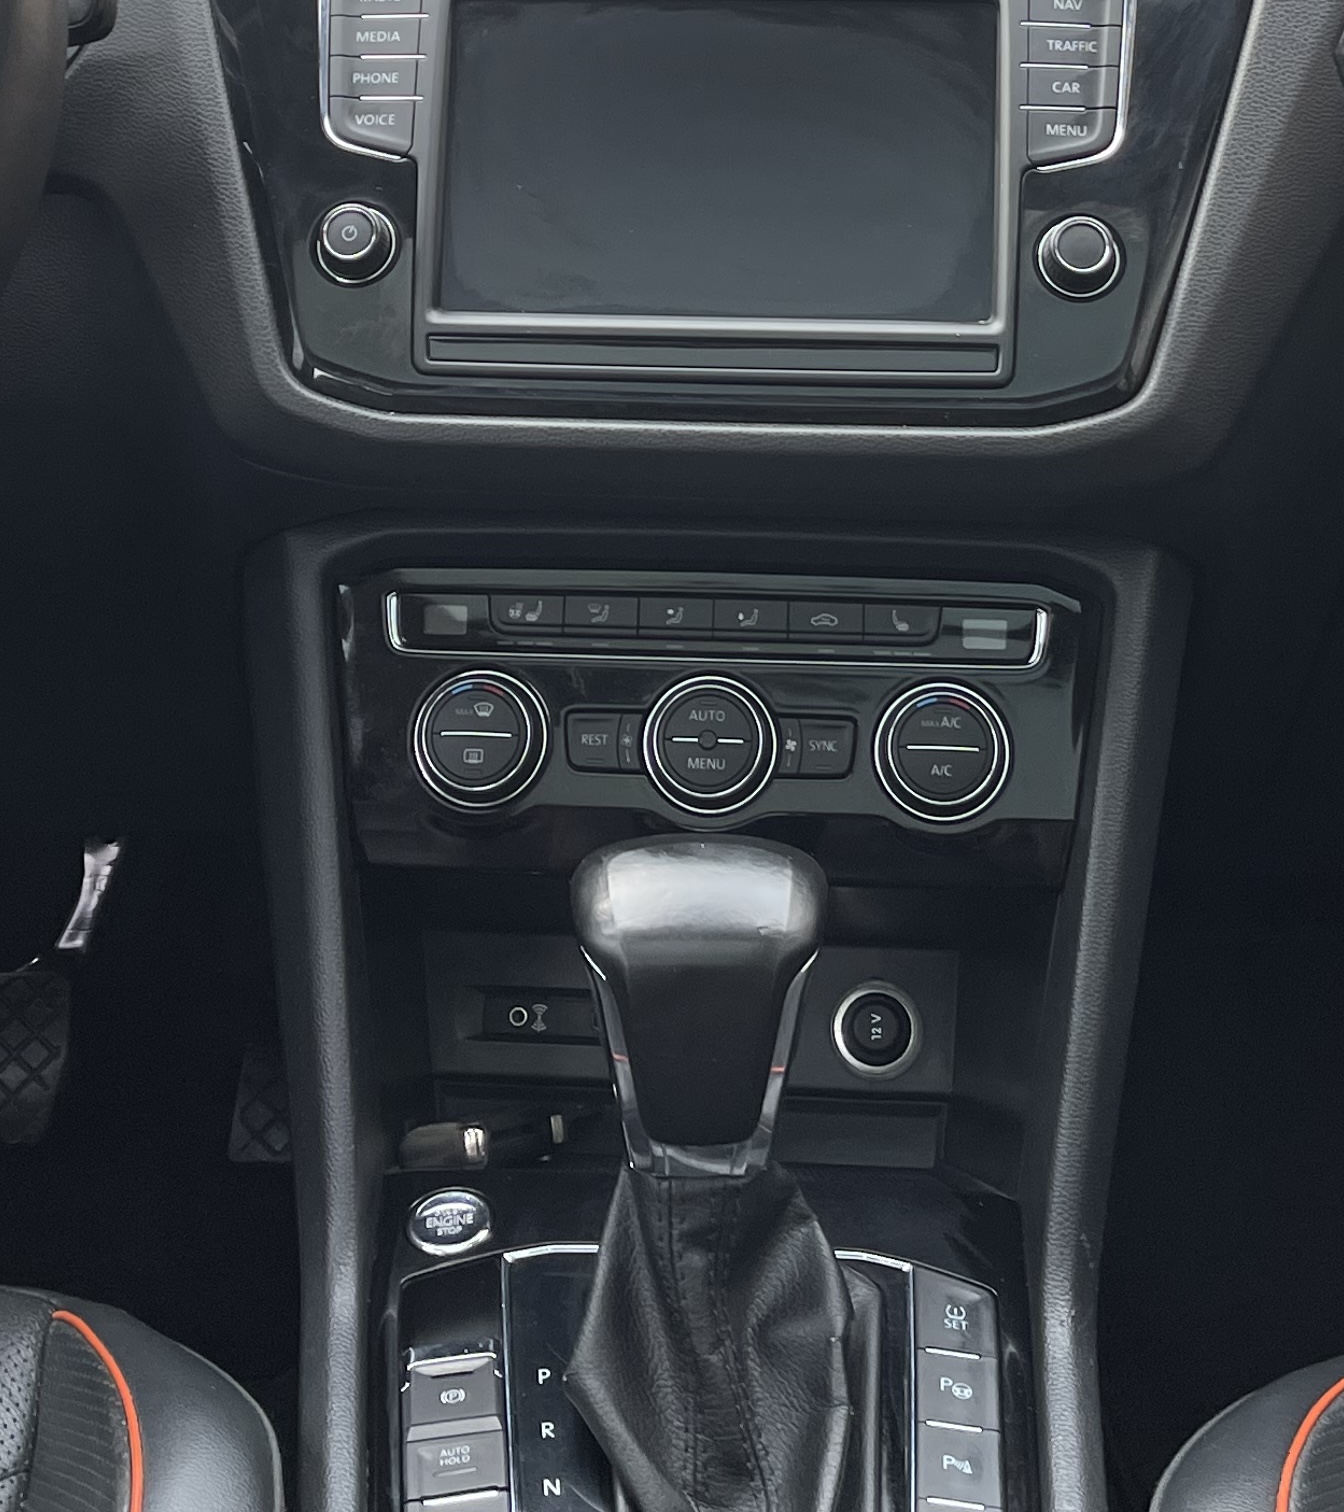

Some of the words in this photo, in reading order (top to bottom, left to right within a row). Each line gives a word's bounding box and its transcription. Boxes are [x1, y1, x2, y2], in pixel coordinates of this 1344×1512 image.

[356, 31, 401, 42] MEDIA
[1046, 39, 1098, 53] TRAFFIC
[352, 72, 399, 84] PHONE
[1051, 81, 1081, 94] CAR
[355, 113, 396, 126] VOICE
[1045, 123, 1087, 137] MENU
[688, 709, 726, 722] AUTO
[940, 715, 962, 729] A/C
[581, 733, 607, 745] REST
[809, 741, 838, 753] SYNC
[687, 757, 726, 770] MENU
[930, 763, 953, 777] A/C
[870, 1013, 882, 1024] V
[870, 1027, 882, 1041] 12
[425, 1213, 474, 1229] ENGINE
[437, 1225, 463, 1236] STOP
[943, 1318, 969, 1331] SET
[537, 1368, 551, 1385] P
[939, 1376, 953, 1392] P
[541, 1422, 556, 1439] R
[440, 1445, 470, 1458] AUTO
[439, 1454, 470, 1466] HOLD
[543, 1478, 561, 1497] N
